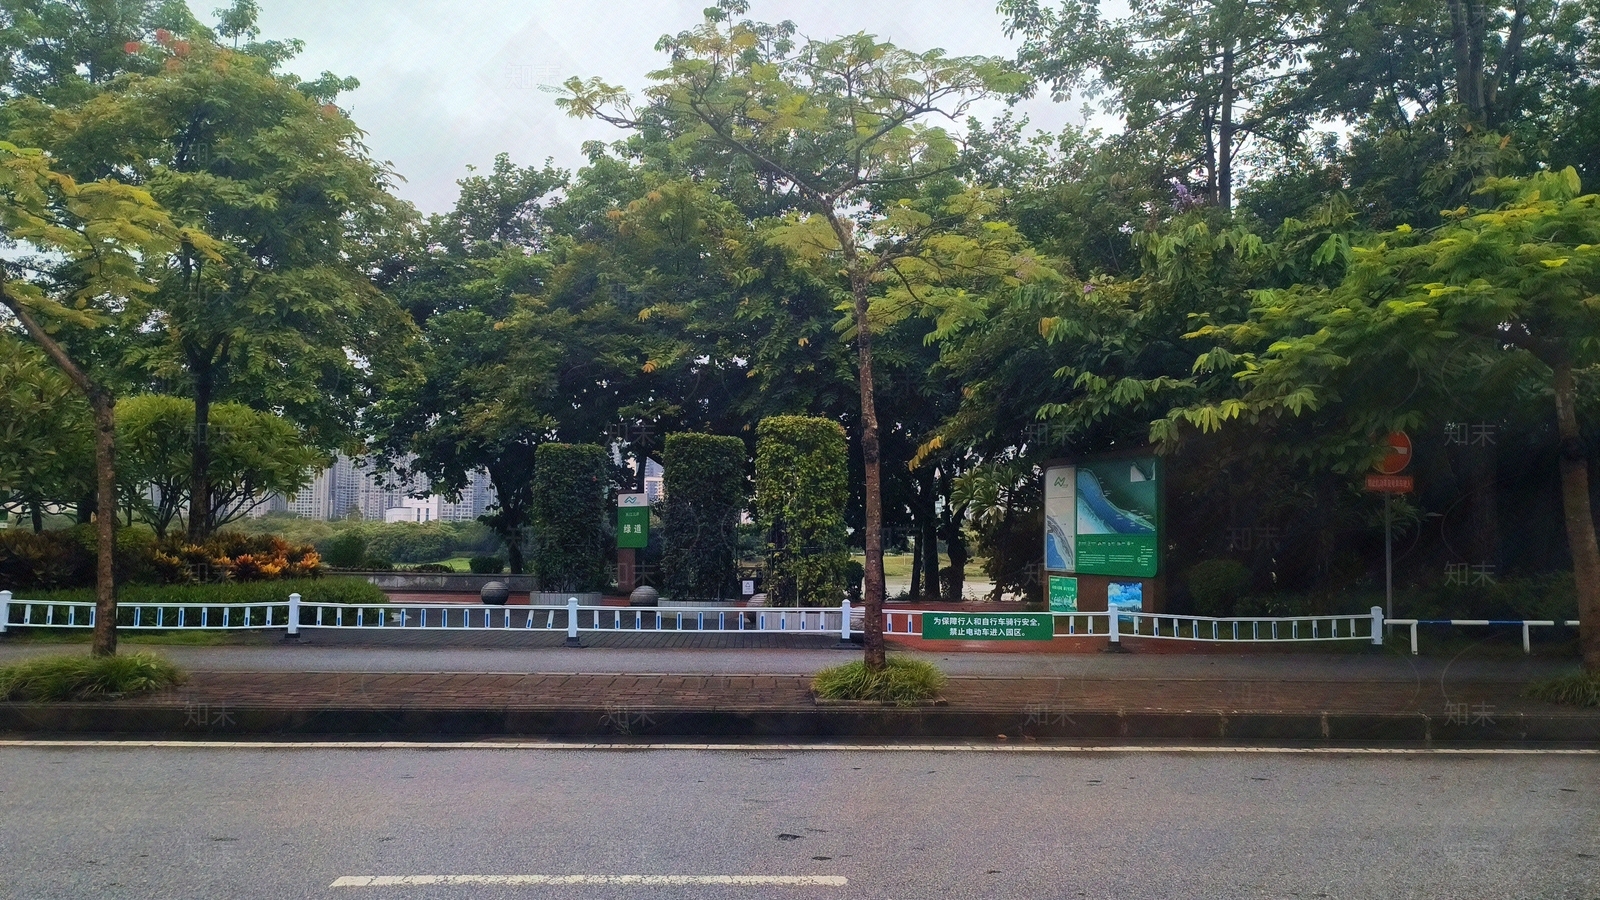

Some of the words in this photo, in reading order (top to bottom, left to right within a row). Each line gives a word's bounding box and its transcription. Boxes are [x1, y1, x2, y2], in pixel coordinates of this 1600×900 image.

[623, 524, 642, 534] 绿道
[949, 628, 1026, 637] 禁止电动车进入园区。
